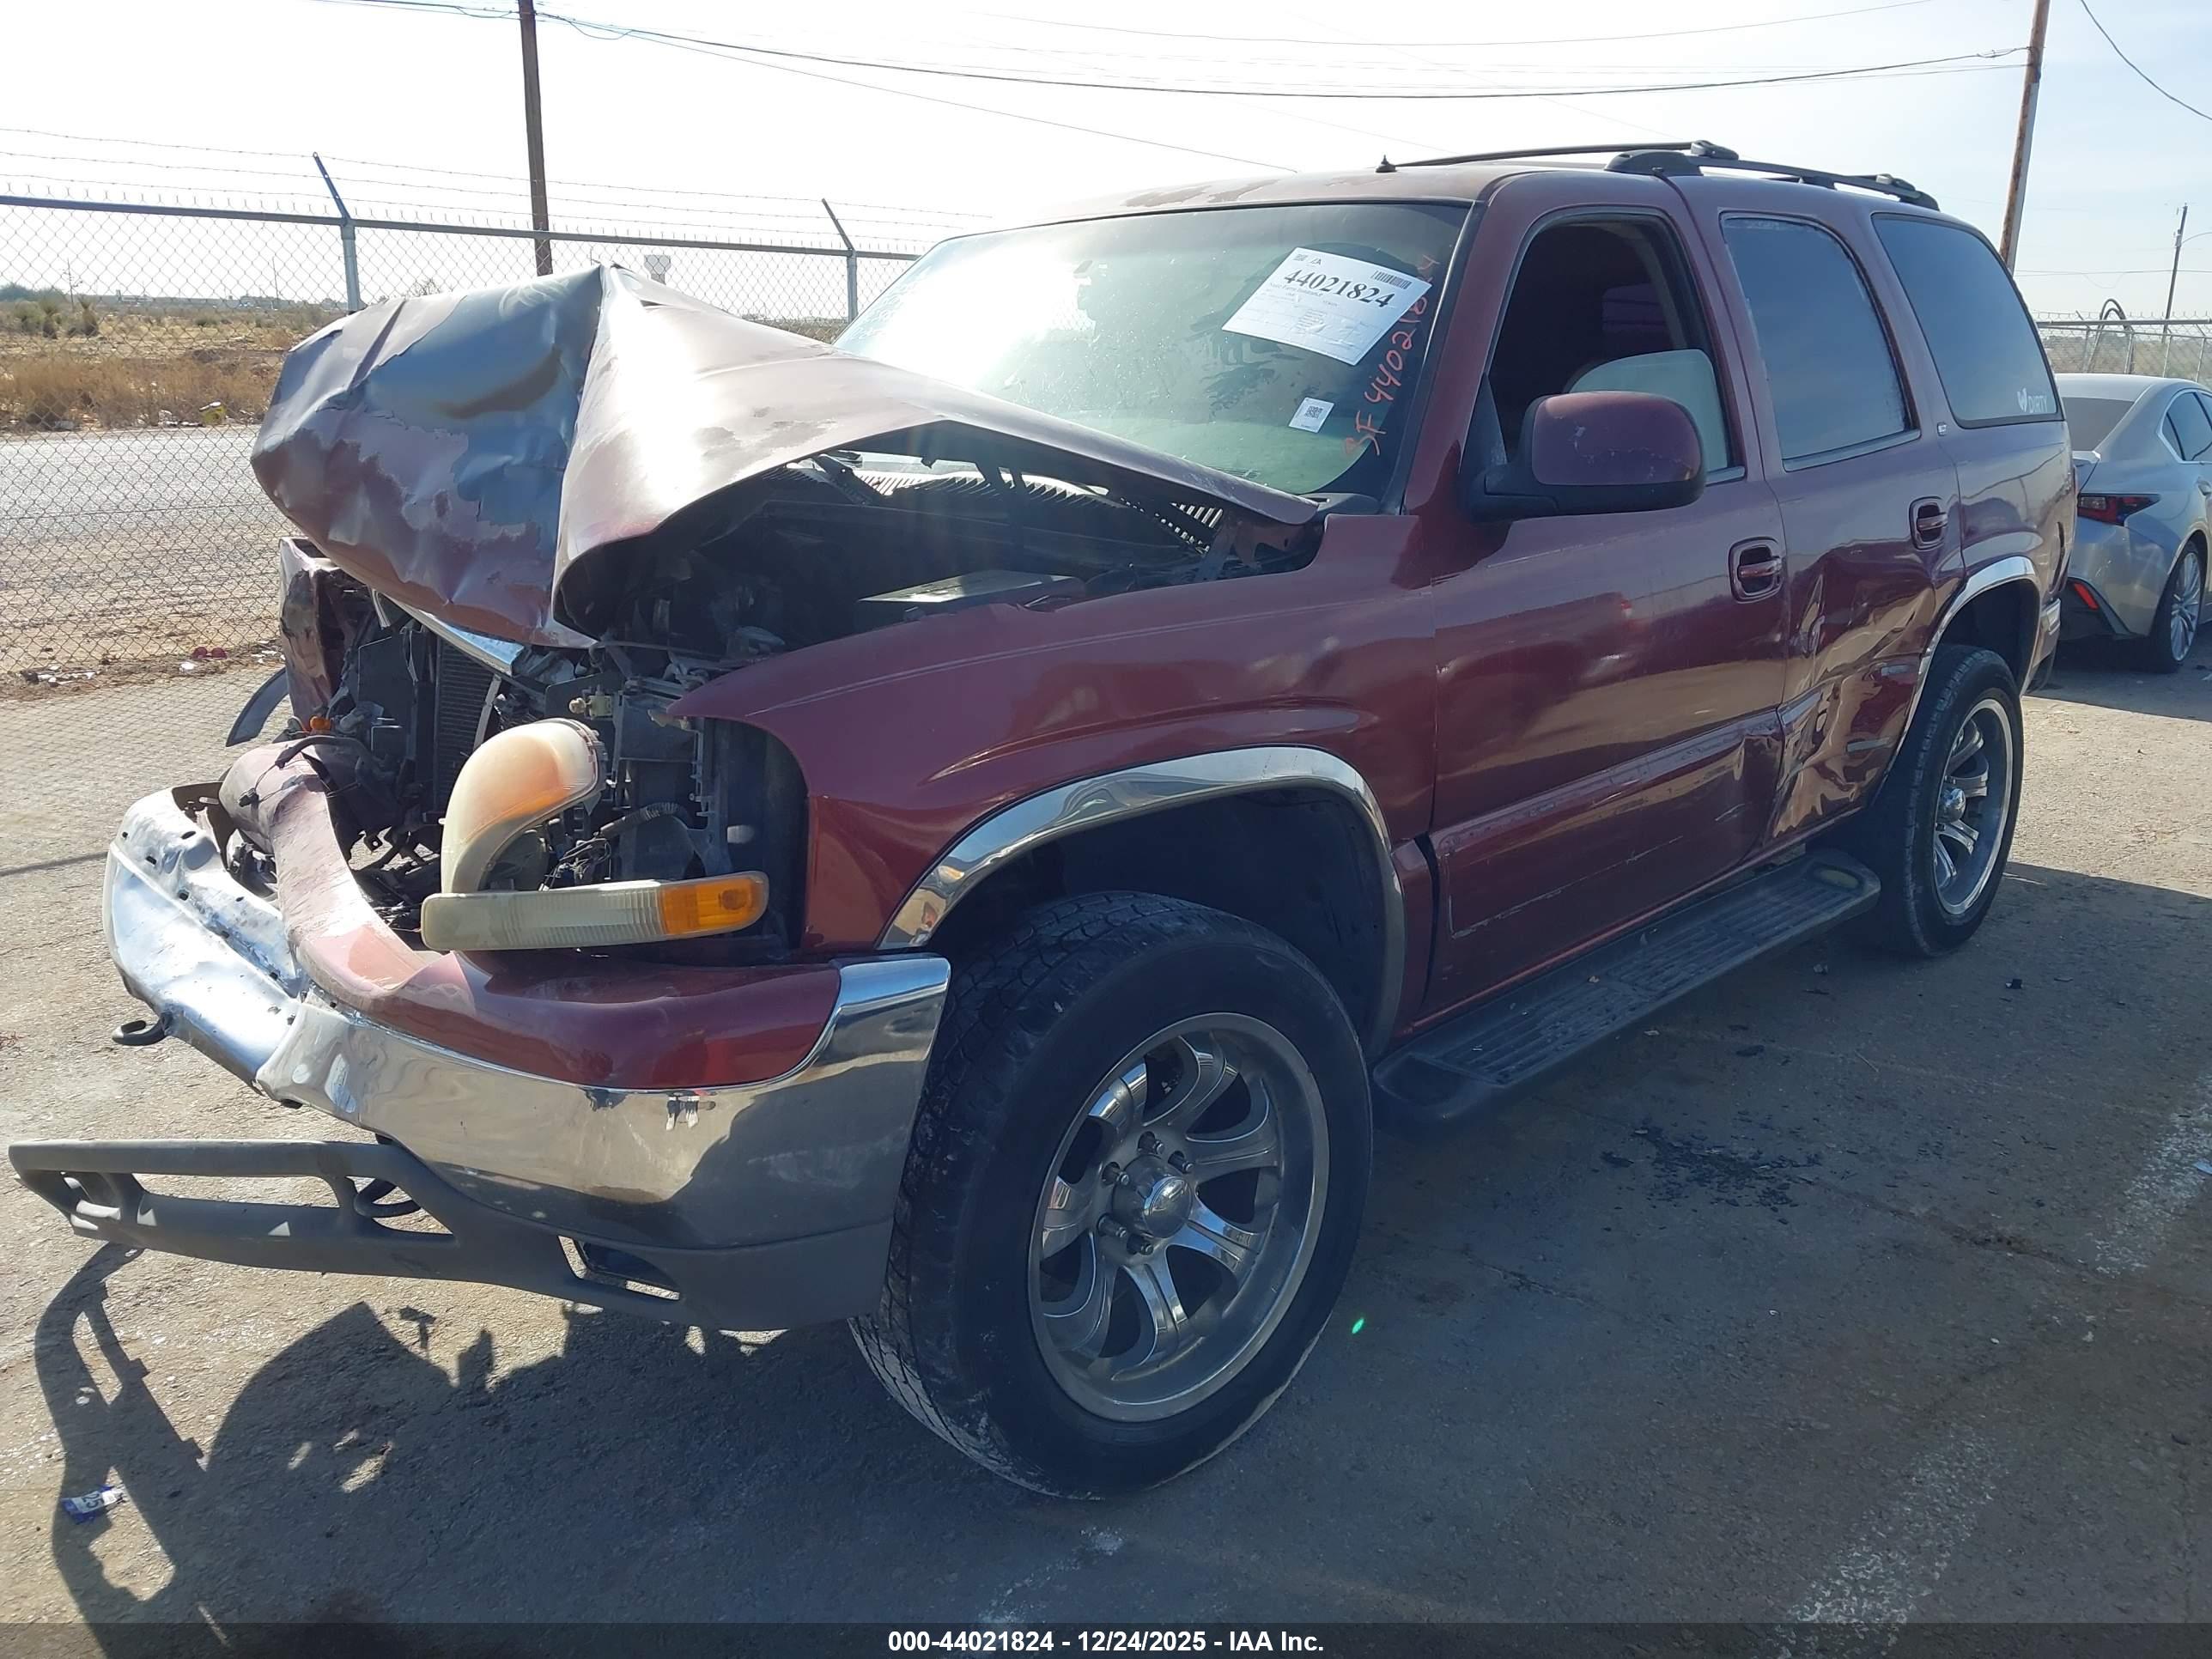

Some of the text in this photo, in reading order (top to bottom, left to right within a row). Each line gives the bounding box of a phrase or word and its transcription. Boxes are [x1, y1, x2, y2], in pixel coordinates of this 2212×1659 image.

[1284, 269, 1395, 307] 44021824
[1364, 254, 1440, 404] 4402184
[2027, 394, 2048, 414] DIRTY
